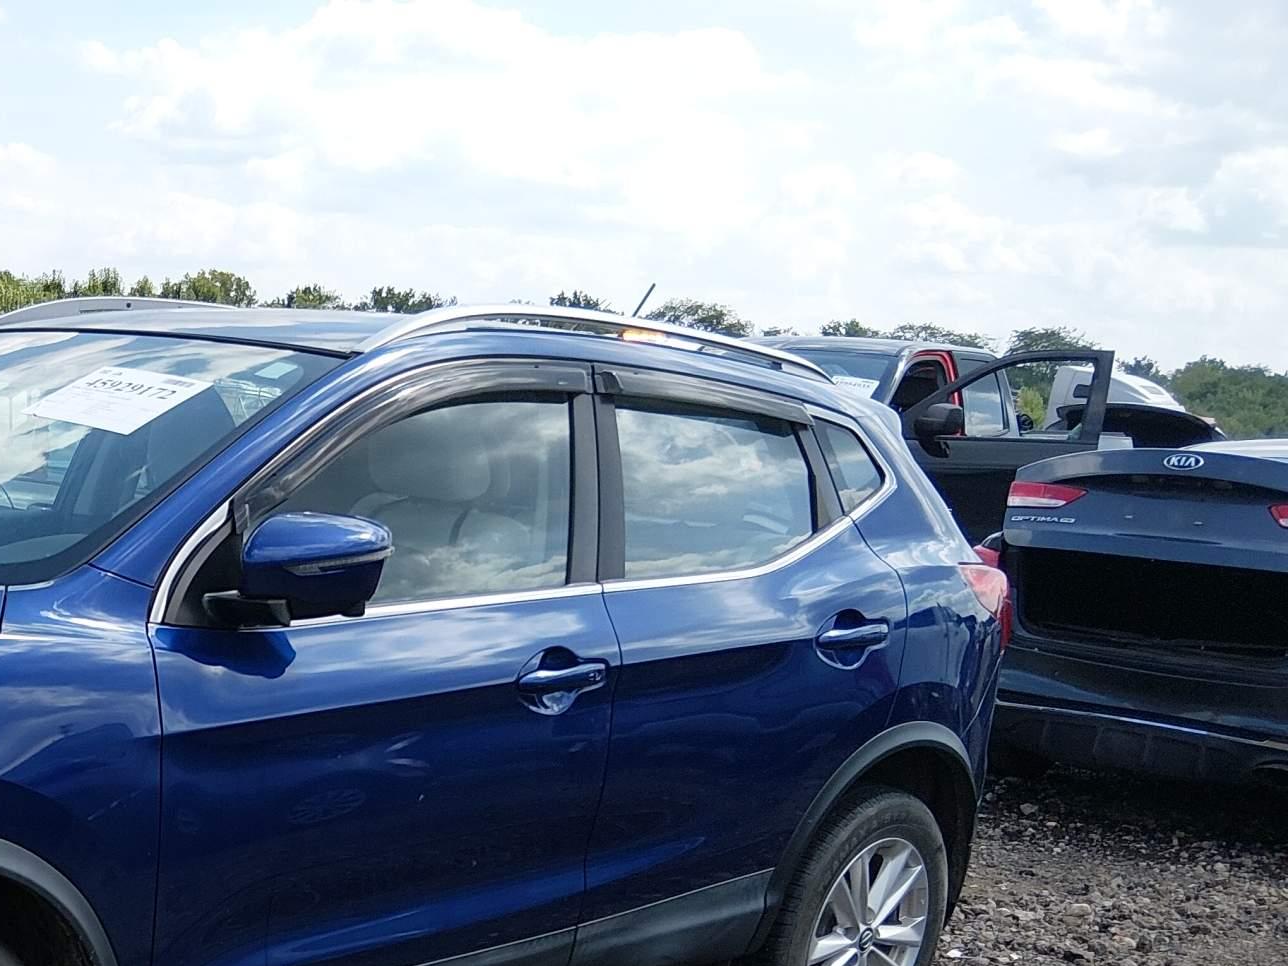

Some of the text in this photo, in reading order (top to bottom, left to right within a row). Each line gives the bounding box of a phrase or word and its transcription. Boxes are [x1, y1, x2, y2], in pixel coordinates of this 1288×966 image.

[85, 378, 177, 400] 45929172
[1169, 454, 1196, 467] KIA
[1011, 514, 1060, 523] OPTIMA
